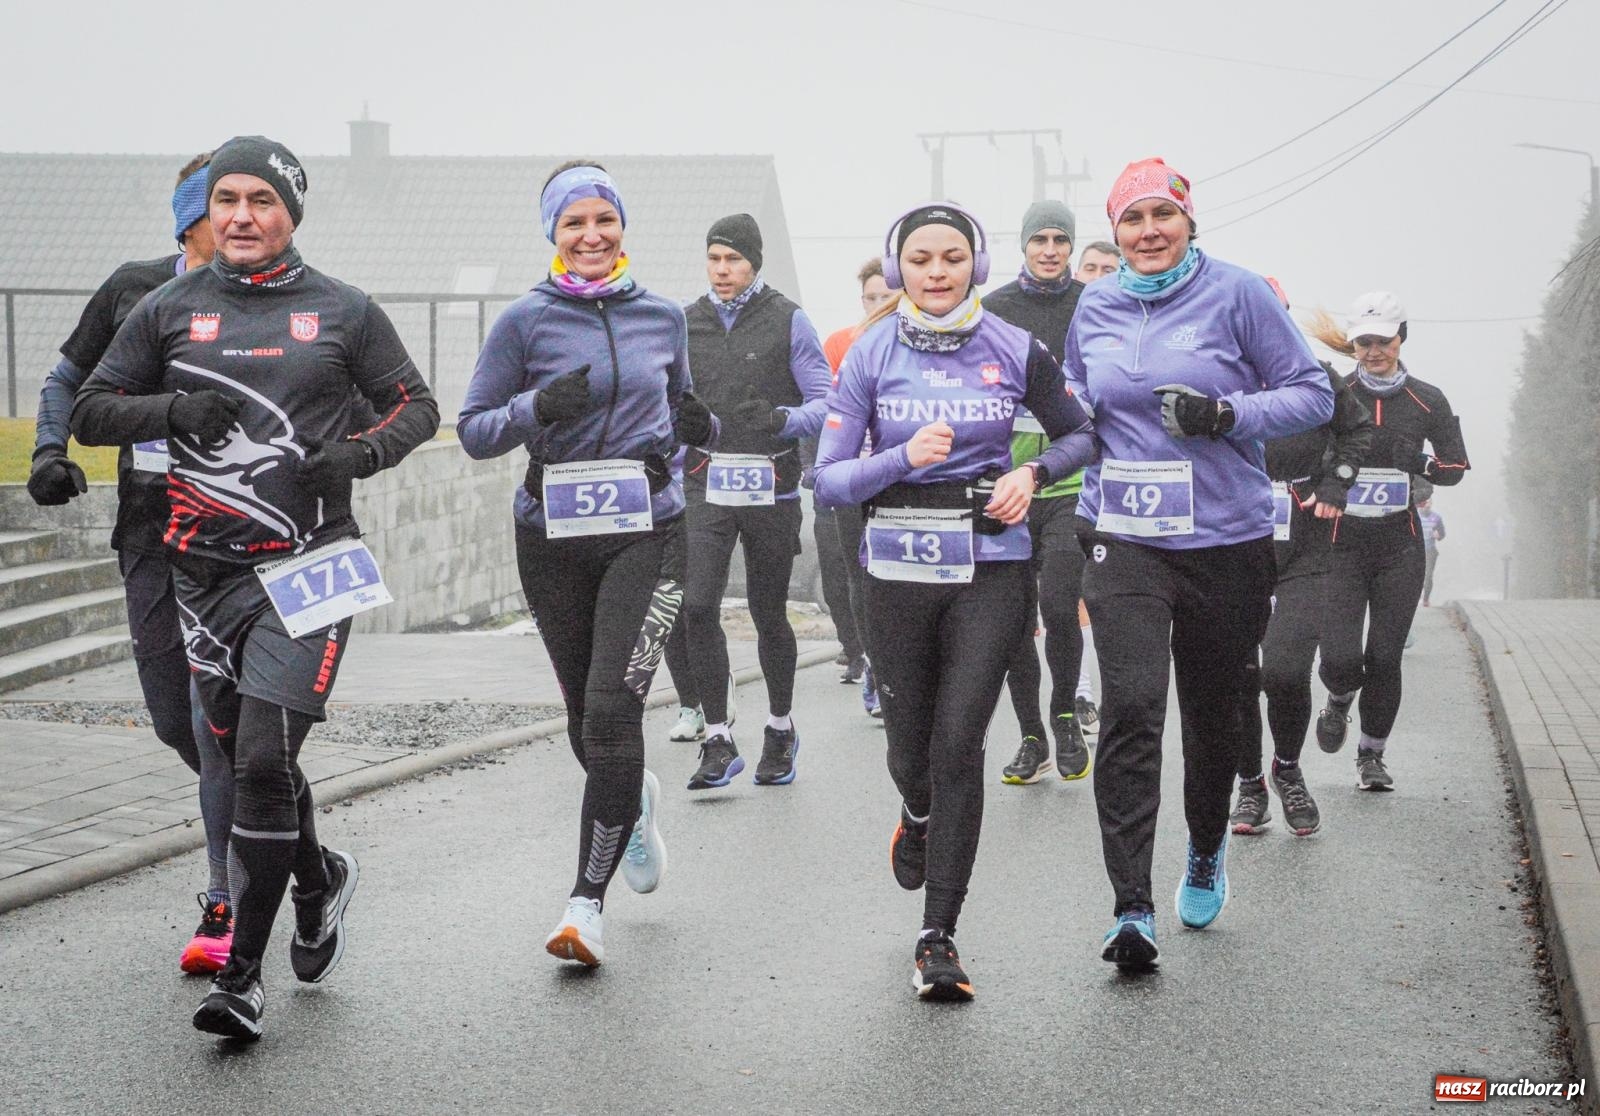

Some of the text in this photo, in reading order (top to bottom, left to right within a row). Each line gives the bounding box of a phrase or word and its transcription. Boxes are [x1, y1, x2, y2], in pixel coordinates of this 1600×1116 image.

[877, 397, 1015, 421] RUNNERS
[719, 469, 763, 491] 153
[1357, 483, 1389, 505] 76
[575, 483, 620, 515] 52
[1121, 485, 1162, 516] 49
[898, 532, 942, 564] 13
[291, 554, 366, 607] 171
